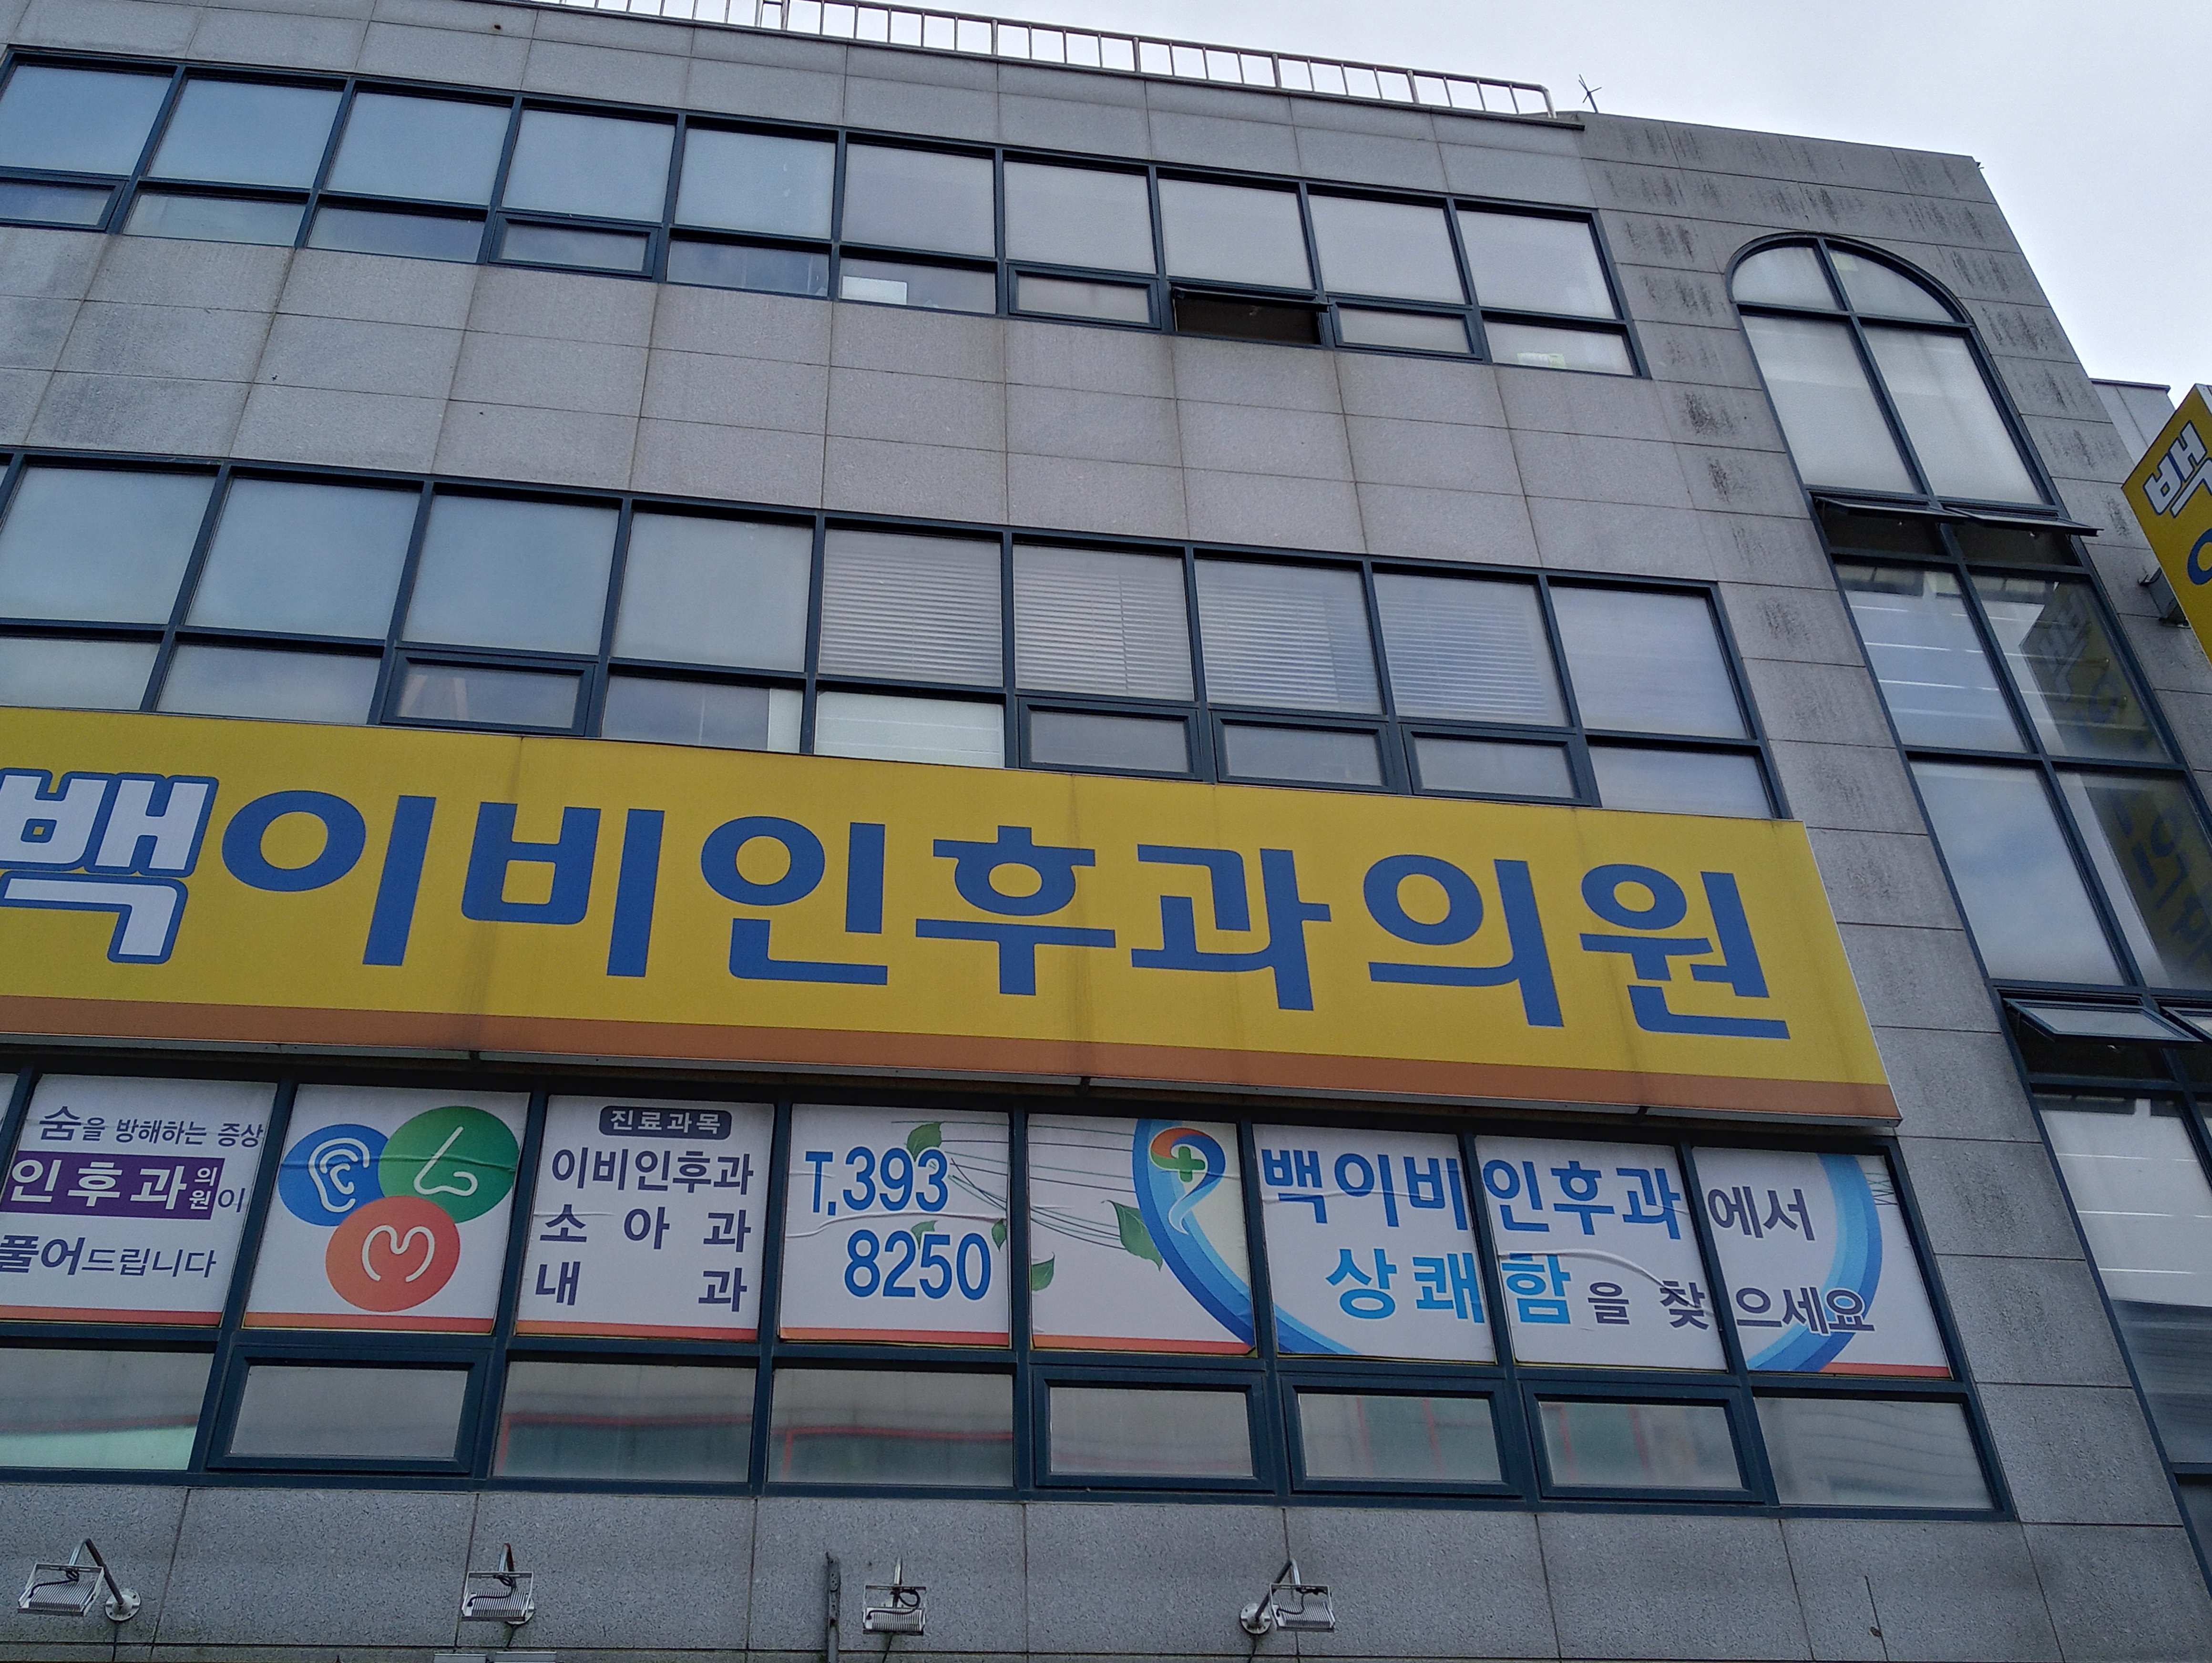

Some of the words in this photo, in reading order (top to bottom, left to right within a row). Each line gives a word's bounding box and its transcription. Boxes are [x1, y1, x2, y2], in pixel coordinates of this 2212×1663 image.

[0, 768, 1791, 1039] 백이비인후과의원
[39, 1106, 105, 1141] 숨을
[116, 1119, 207, 1144] 방해하는
[217, 1122, 264, 1148] 증상
[610, 1109, 721, 1134] 진료과목
[552, 1147, 754, 1195] 이비인후과
[844, 1229, 991, 1301] 8250
